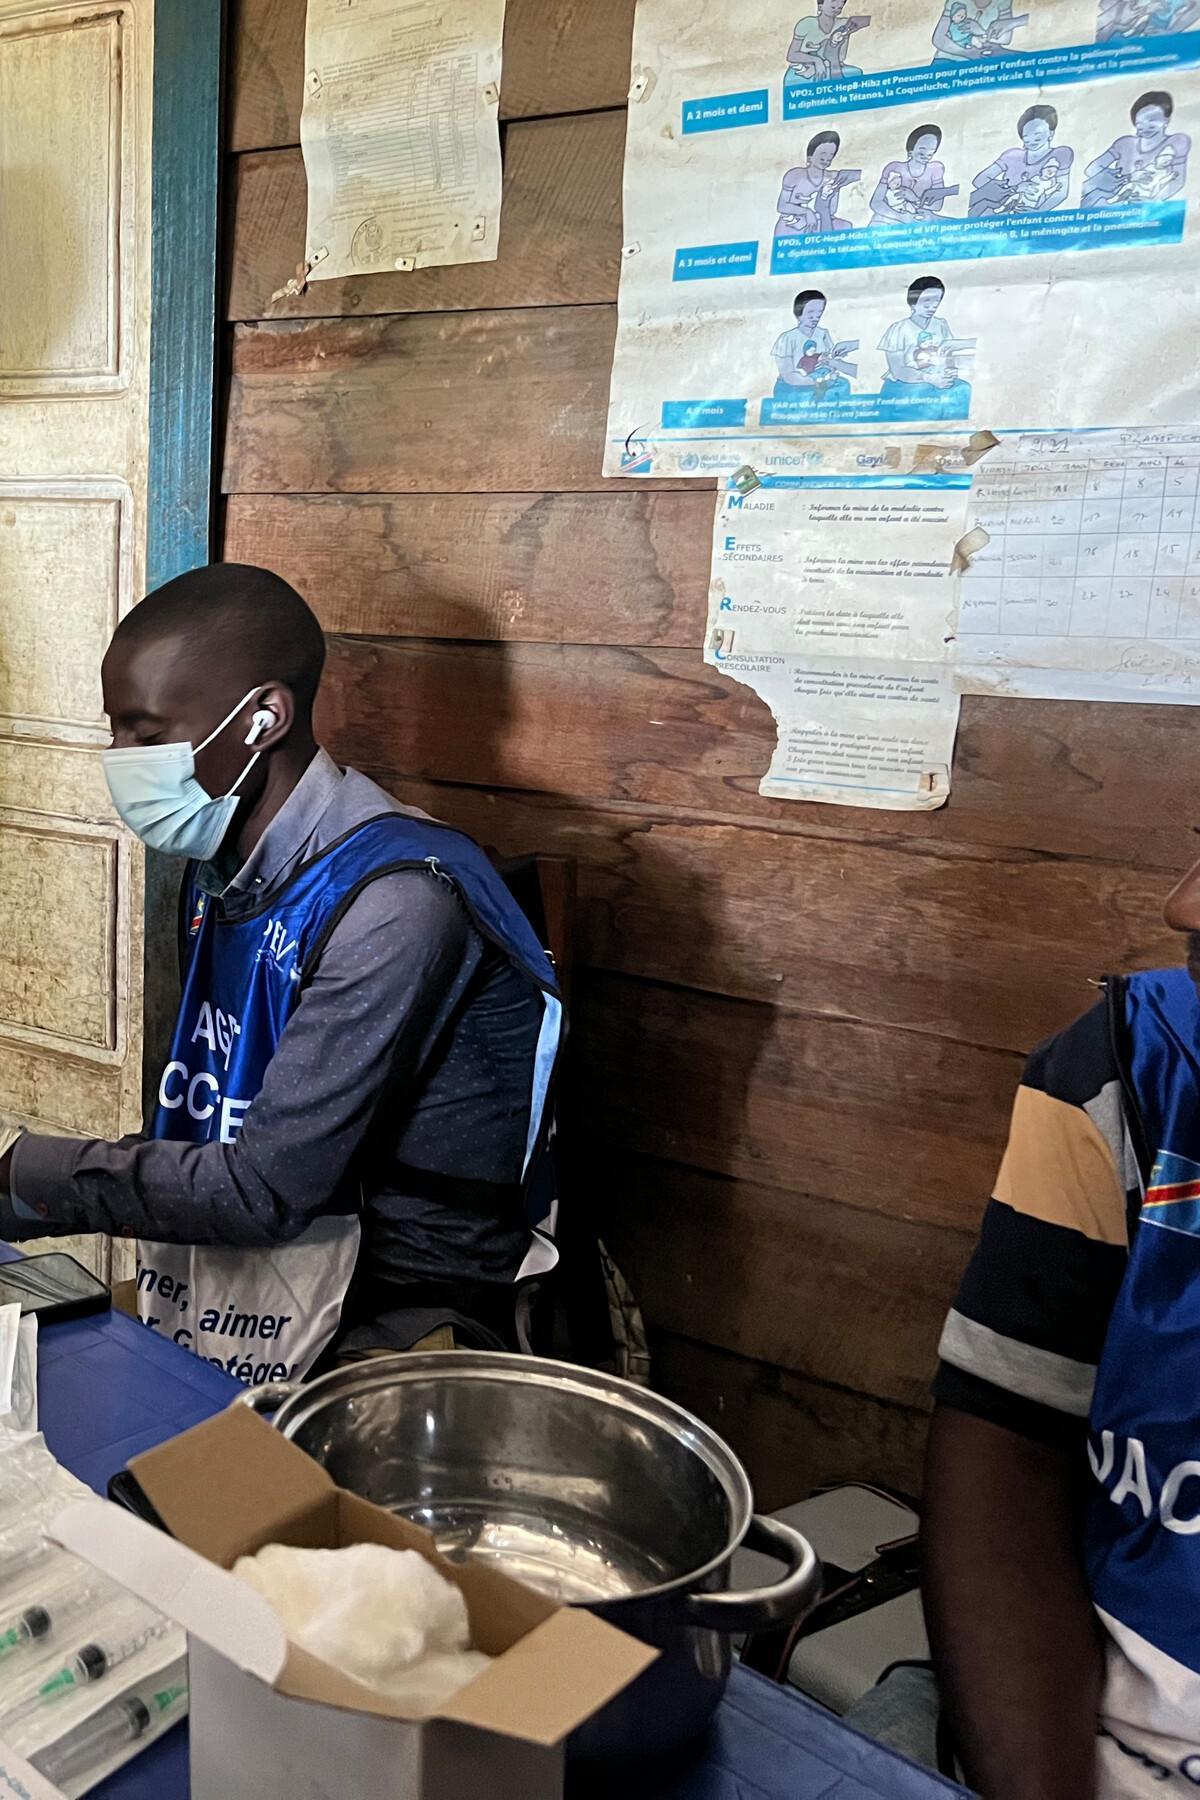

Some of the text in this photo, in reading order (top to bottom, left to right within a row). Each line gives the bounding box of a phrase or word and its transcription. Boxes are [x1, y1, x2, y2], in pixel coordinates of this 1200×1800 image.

[934, 70, 956, 80] pour
[958, 64, 999, 77] protéger
[1037, 55, 1068, 65] contre
[895, 82, 950, 95] Coqueluche,
[686, 103, 762, 119] A 2 mois et demi
[1006, 215, 1042, 226] l'enfant
[1043, 214, 1075, 223] contre
[1074, 212, 1085, 220] la
[678, 259, 685, 267] A
[693, 257, 716, 266] mois
[717, 256, 726, 264] et
[727, 254, 751, 263] demi
[765, 452, 808, 466] unicef
[727, 495, 775, 511] MALADIE
[725, 536, 761, 552] EFFETS
[723, 551, 784, 562] SÉCONDAIRES
[720, 597, 787, 615] RENDEZ-VOUS
[715, 648, 785, 665] CONSULTATION
[137, 1262, 188, 1312] ner,
[200, 1304, 292, 1340] aimer
